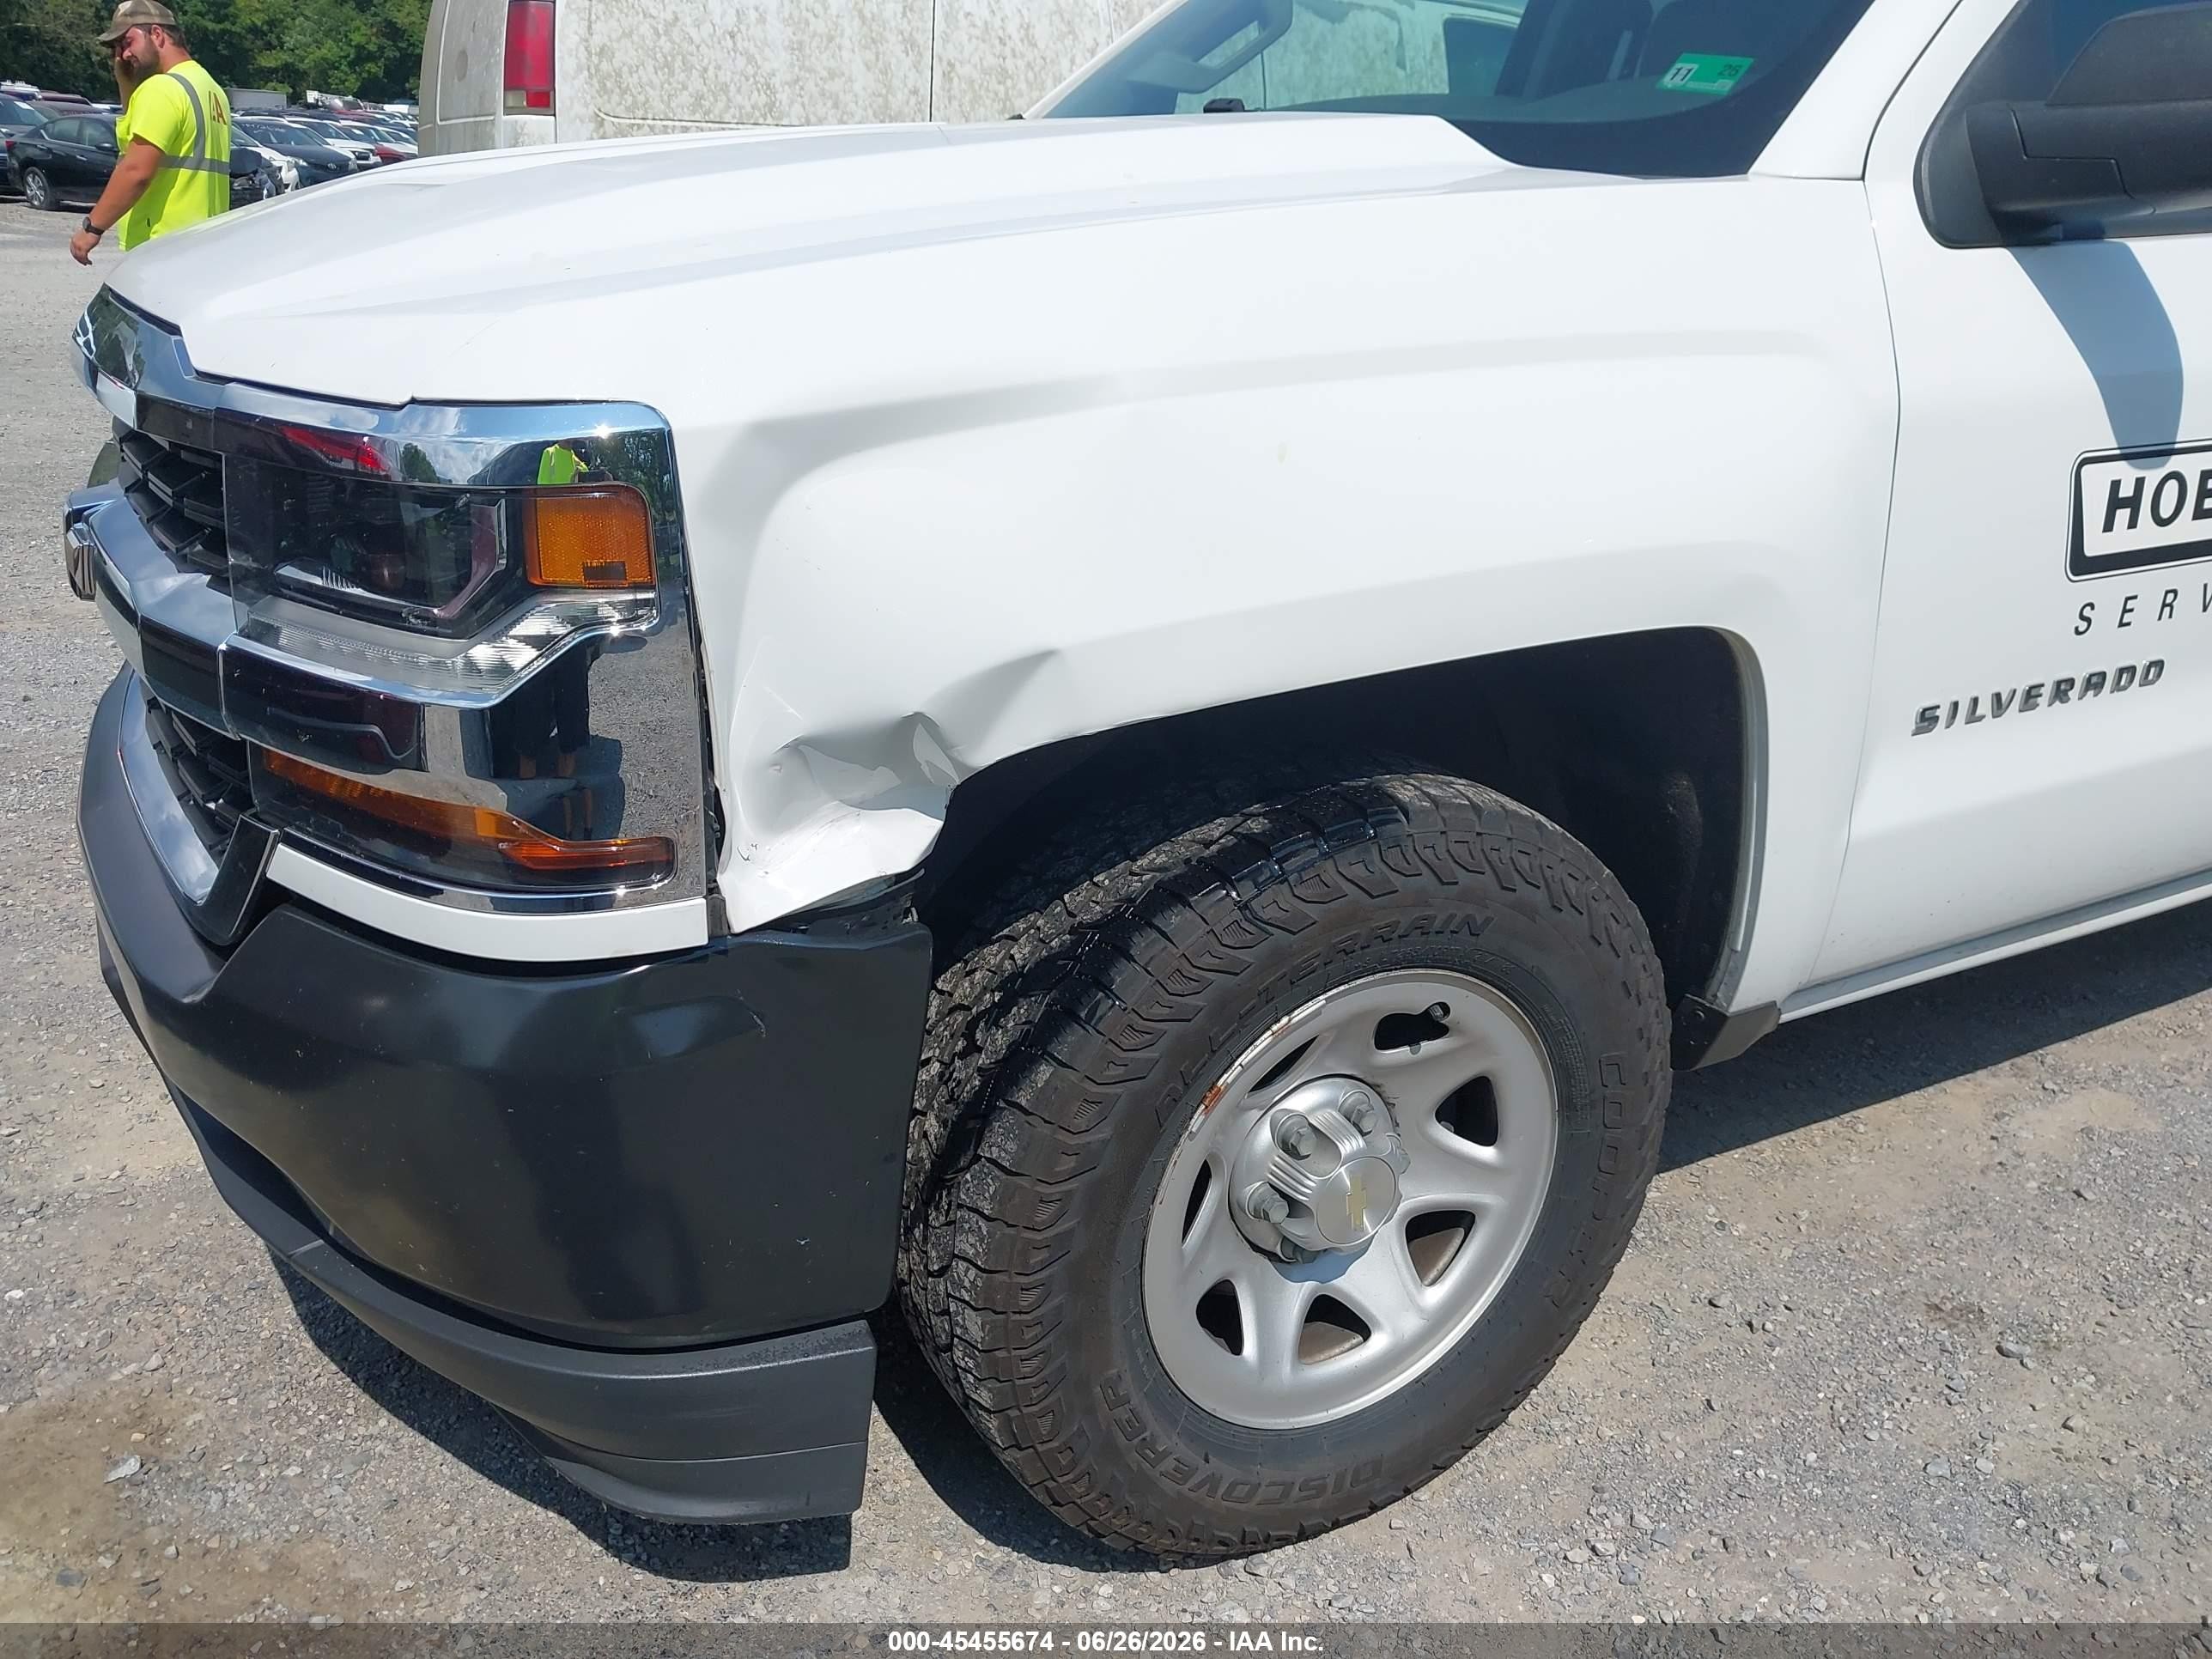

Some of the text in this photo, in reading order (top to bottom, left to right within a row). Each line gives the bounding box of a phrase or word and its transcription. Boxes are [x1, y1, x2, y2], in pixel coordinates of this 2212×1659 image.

[1669, 67, 1695, 82] 11
[1911, 659, 2166, 737] SILVERADO
[1097, 1369, 1385, 1505] DISCOVERER
